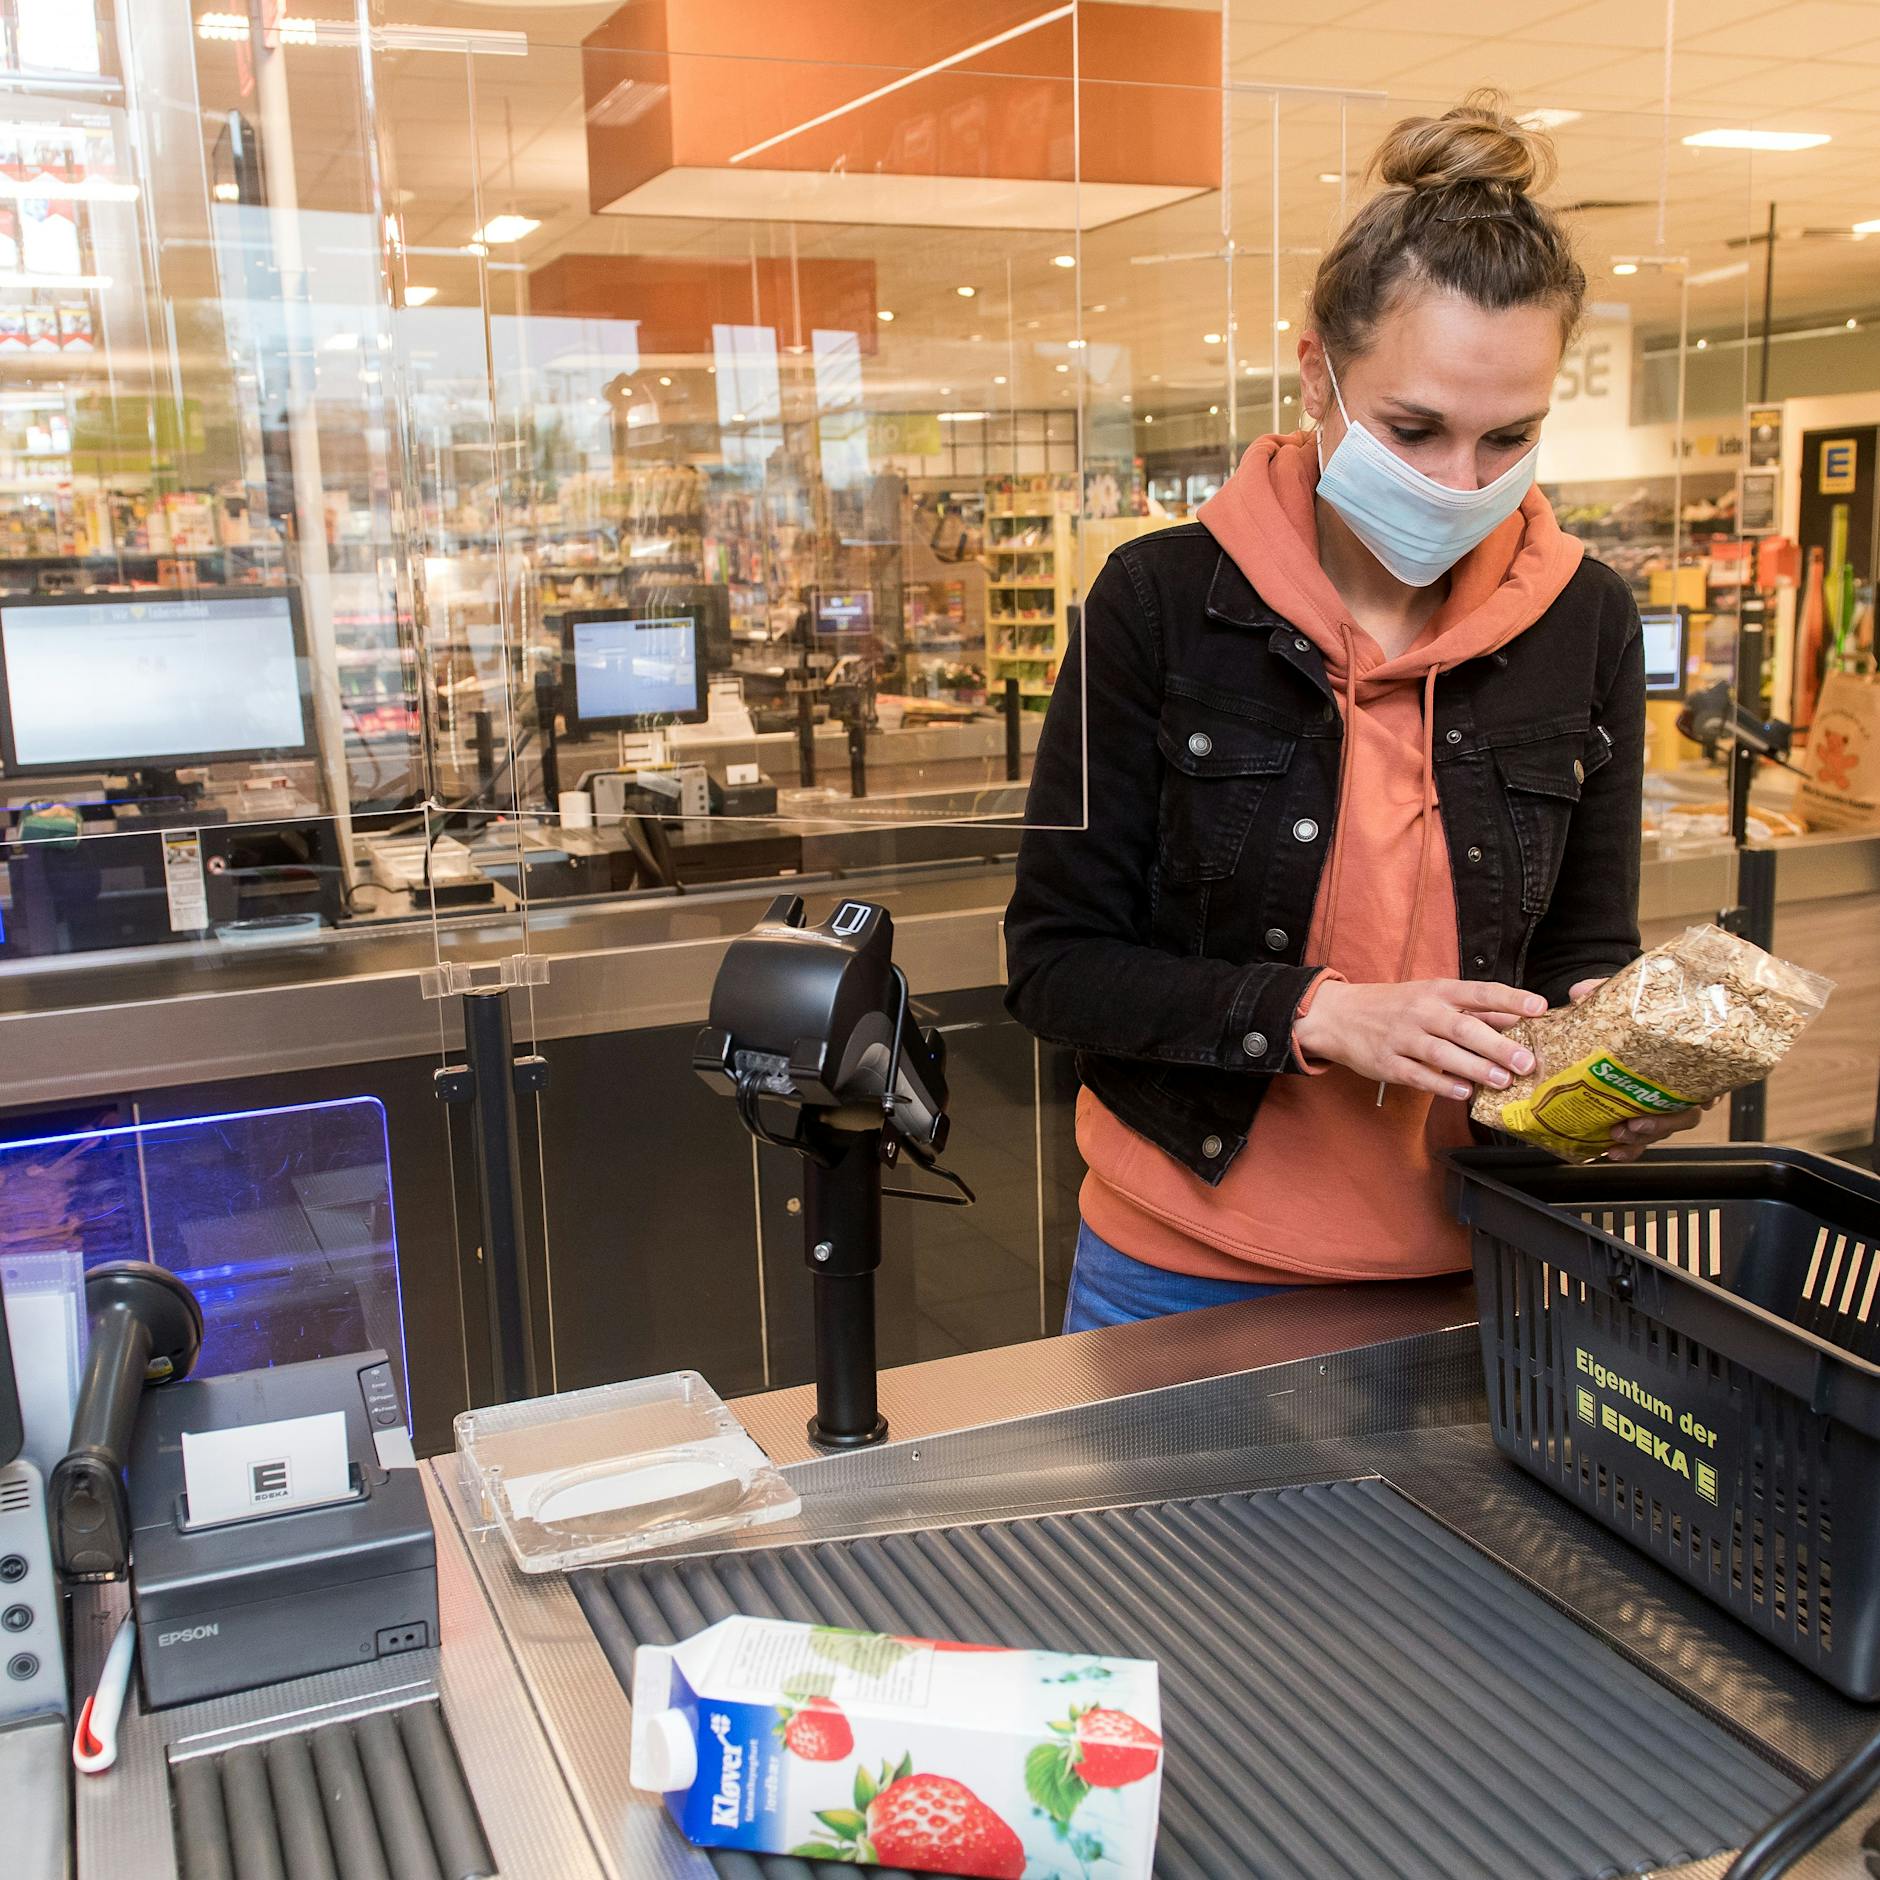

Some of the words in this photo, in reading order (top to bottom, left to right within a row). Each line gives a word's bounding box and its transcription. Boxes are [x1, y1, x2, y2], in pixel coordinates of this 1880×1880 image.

[1826, 448, 1850, 478] E
[1576, 1347, 1674, 1425] Eigentum
[1679, 1412, 1718, 1450] der
[1601, 1403, 1690, 1480] EDEKA
[253, 1462, 287, 1494] E
[254, 1490, 289, 1502] EDEKA
[158, 1623, 219, 1647] EPSON
[711, 1741, 743, 1829] Kløver
